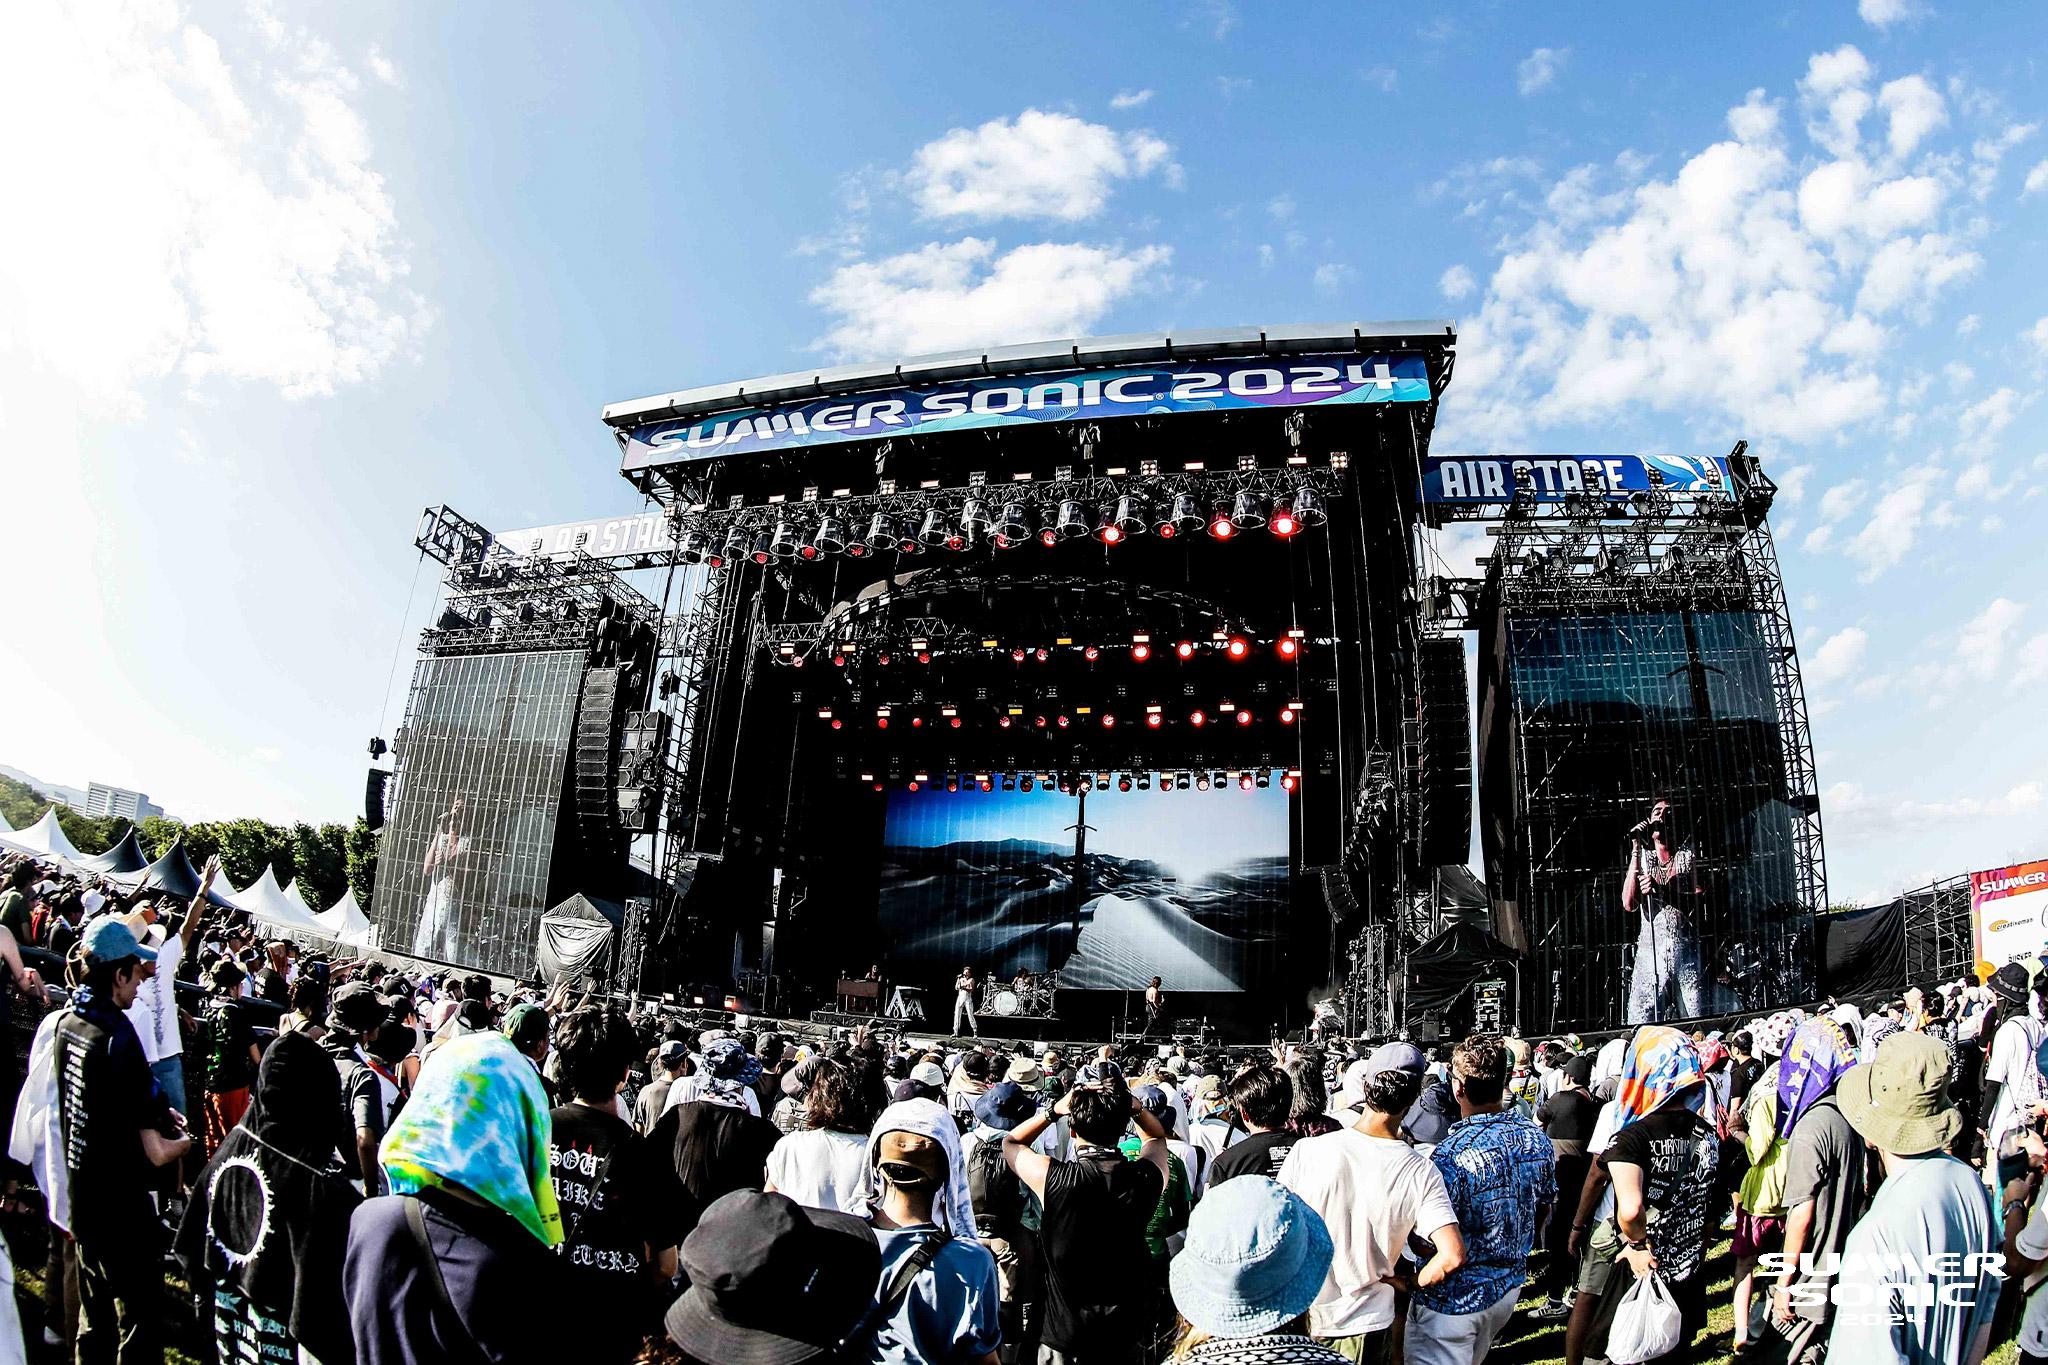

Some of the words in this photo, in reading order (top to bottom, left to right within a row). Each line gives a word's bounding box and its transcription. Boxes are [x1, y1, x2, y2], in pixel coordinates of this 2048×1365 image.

[646, 399, 906, 456] SUMMER
[920, 374, 1154, 421] SONIC
[1172, 363, 1399, 400] 2024
[1439, 460, 1507, 498] AIR
[1980, 871, 2047, 895] SUMMER
